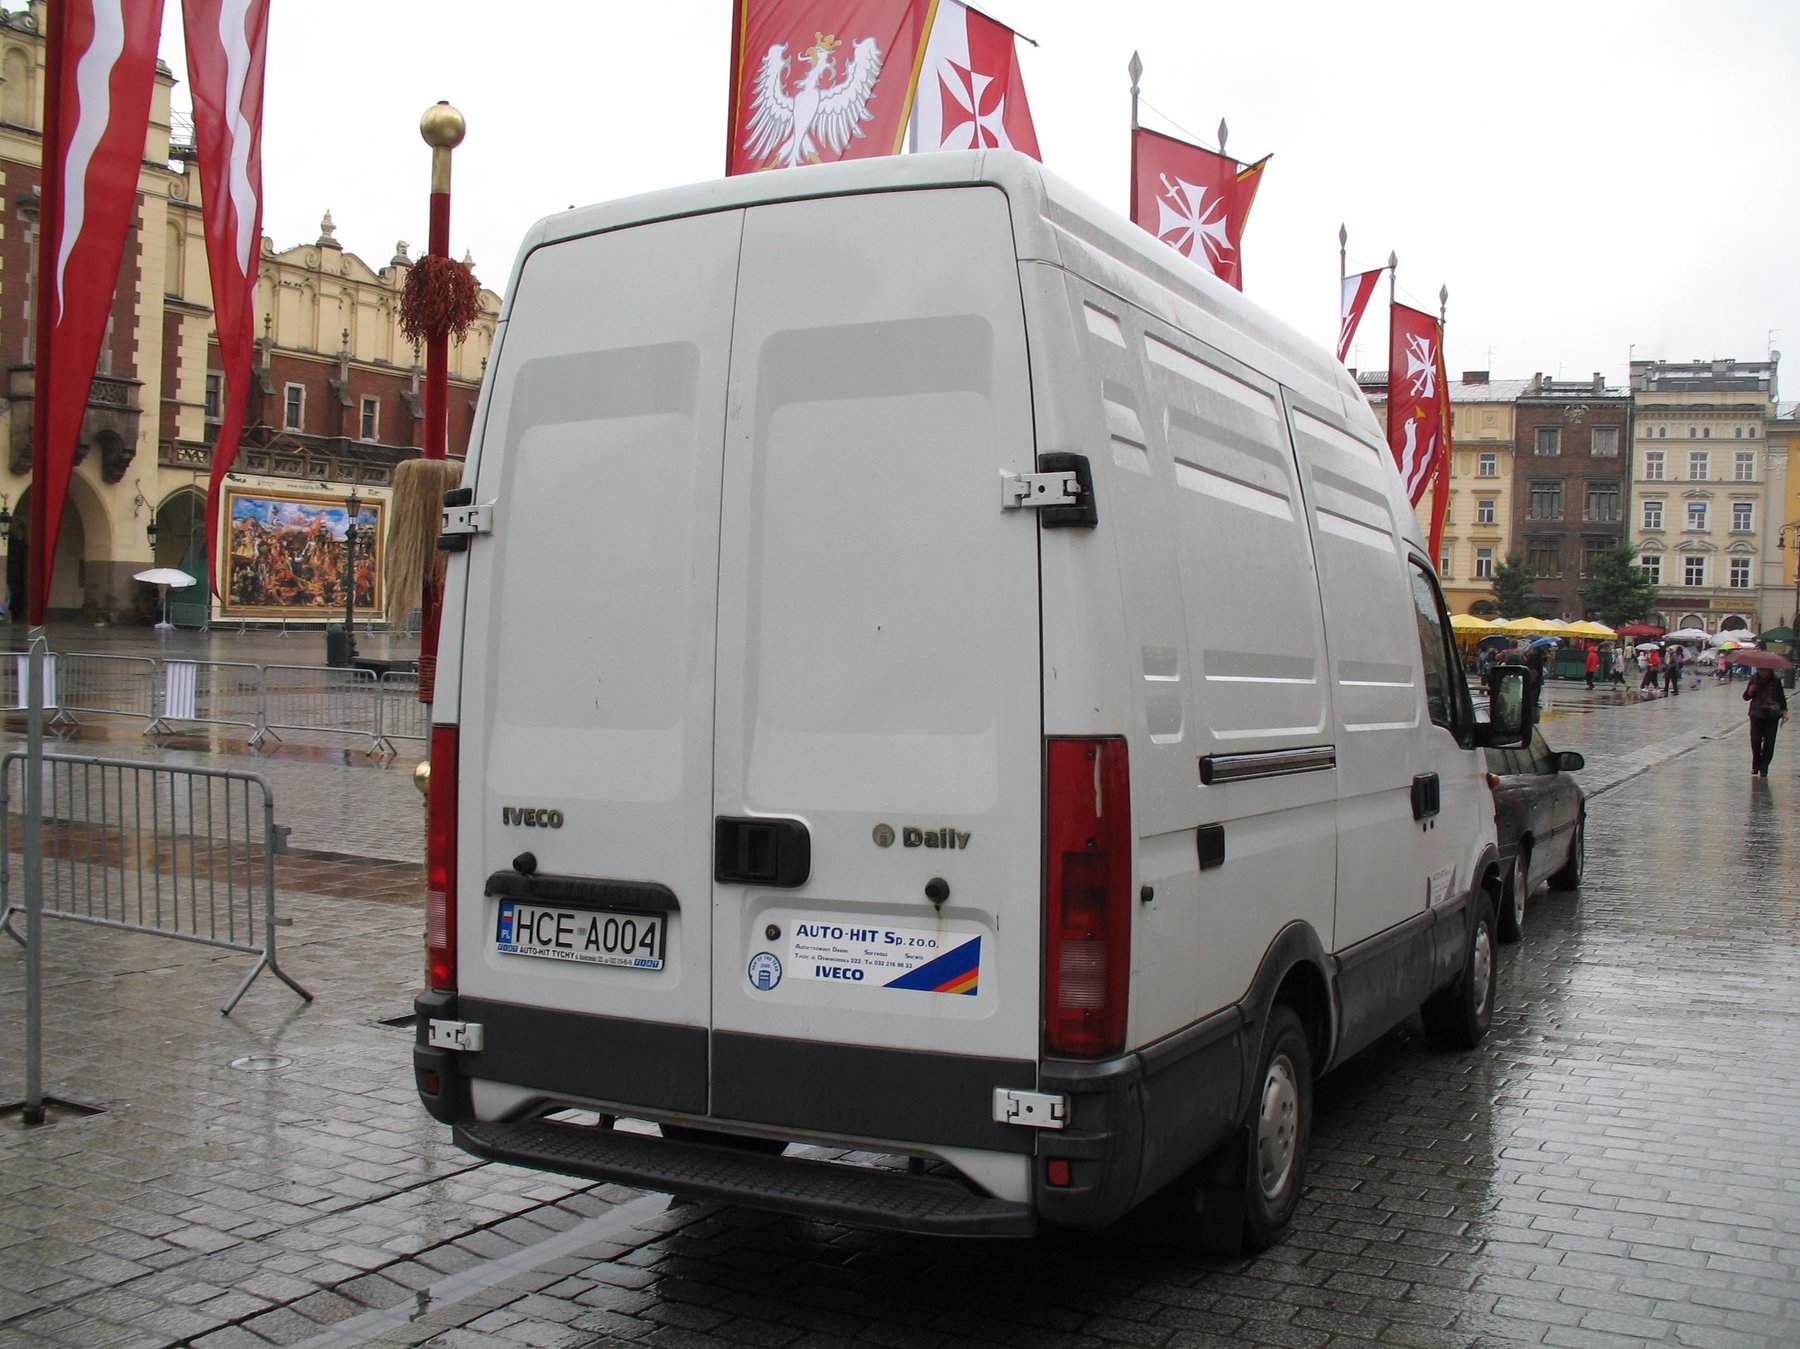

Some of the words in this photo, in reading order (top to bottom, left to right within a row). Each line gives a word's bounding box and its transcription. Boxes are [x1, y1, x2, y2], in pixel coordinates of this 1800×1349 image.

[503, 807, 564, 829] IVECO
[903, 827, 971, 850] Daily
[501, 929, 511, 939] PL
[516, 909, 575, 948] HCE
[584, 916, 656, 957] A004
[796, 924, 879, 943] AUTO-HIT
[519, 946, 551, 956] AUTO-HIT
[552, 949, 575, 959] TYCHY
[633, 958, 660, 968] FIAT
[815, 965, 865, 981] IVECO
